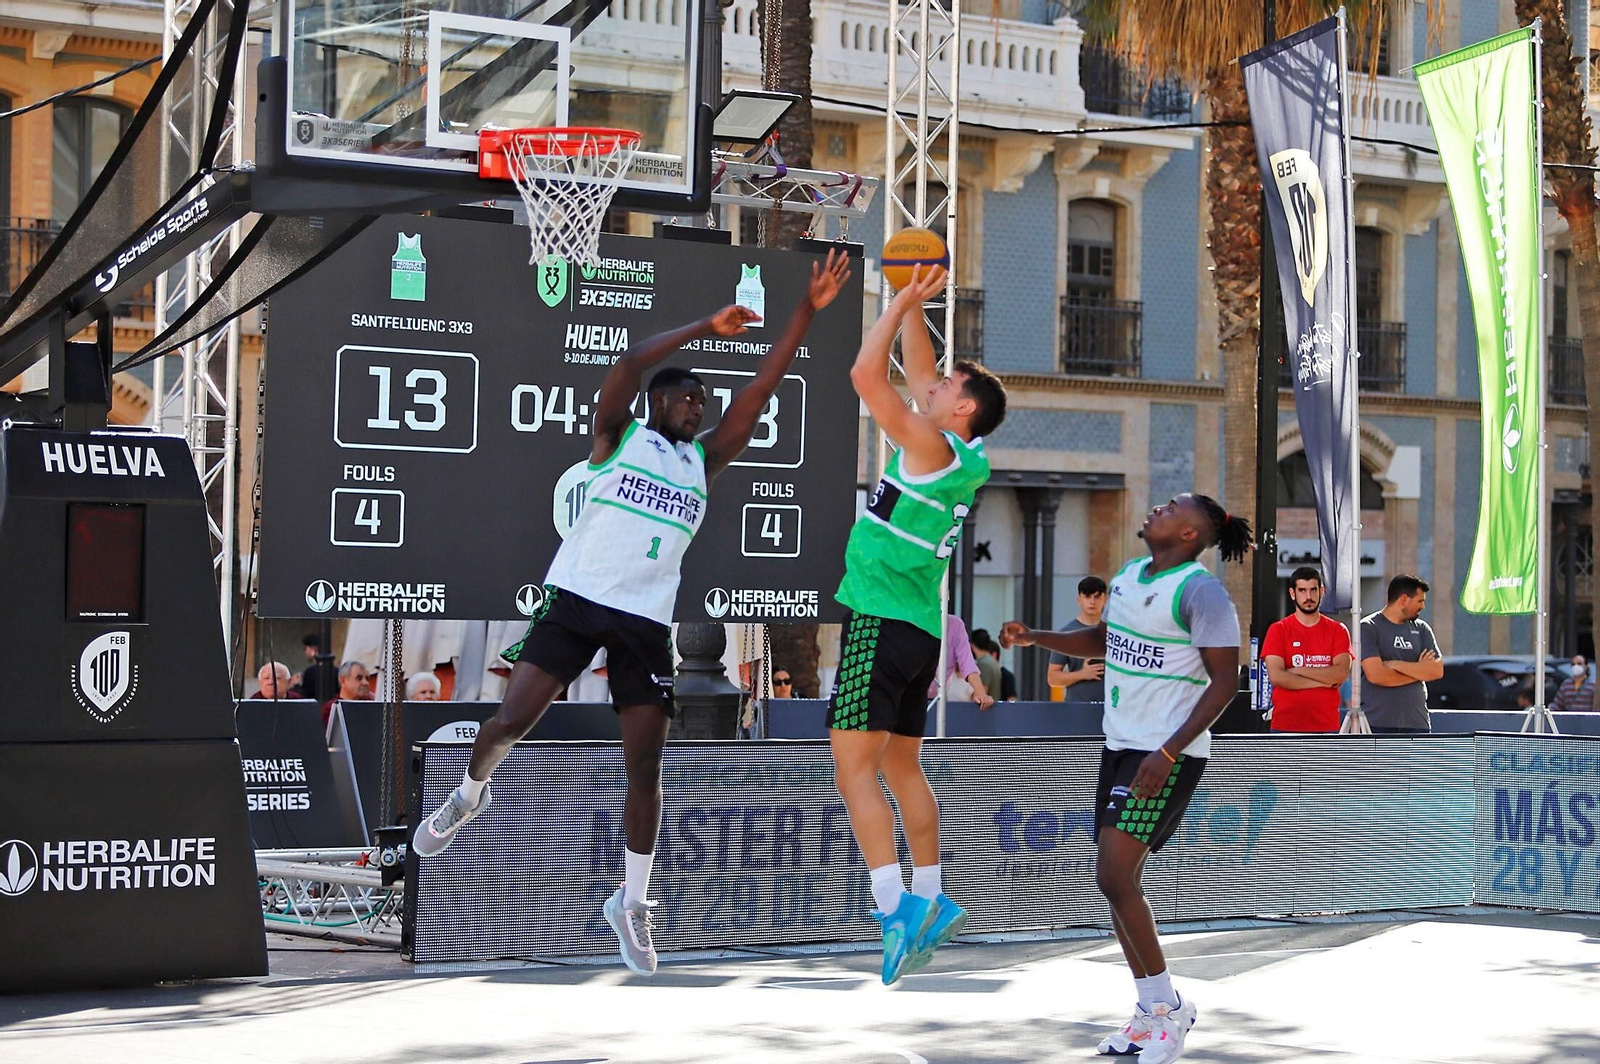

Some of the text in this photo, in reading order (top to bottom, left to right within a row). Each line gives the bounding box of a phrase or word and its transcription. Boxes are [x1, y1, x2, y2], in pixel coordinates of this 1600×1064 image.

[332, 127, 367, 135] NUTRITION
[322, 136, 366, 147] 3X3SERIES
[635, 158, 683, 170] HERBALIFE
[635, 166, 683, 178] NUTRITION
[118, 197, 208, 269] Schelde Sports
[598, 257, 654, 272] HERBALIFE
[597, 269, 654, 284] NUTRITION
[579, 289, 653, 310] 3X3SERIES
[351, 313, 473, 335] SANTFELIUENC 3X3
[564, 323, 628, 352] HUELVA
[564, 353, 580, 363] 9-10
[580, 354, 590, 364] DE
[589, 355, 609, 365] JUNIO
[367, 365, 448, 432] 13
[41, 441, 166, 478] HUELVA
[343, 464, 395, 482] FOULS
[621, 473, 701, 513] HERBALIFE
[752, 482, 794, 498] FOULS
[353, 498, 381, 535] 4
[760, 513, 783, 546] 4
[646, 537, 662, 560] 1
[338, 582, 446, 598] HERBALIFE
[731, 589, 818, 605] HERBALIFE
[338, 597, 446, 613] NUTRITION
[730, 603, 818, 618] NUTRITION
[110, 636, 126, 645] FEB
[1107, 631, 1165, 658] RBALIFE
[1107, 645, 1163, 669] TRITION
[455, 727, 476, 738] FEB
[241, 759, 304, 771] RBALIFE
[246, 793, 310, 811] SERIES
[1494, 781, 1600, 847] MÁS
[43, 837, 216, 865] HERBALIFE
[43, 863, 216, 892] NUTRITION
[1492, 846, 1581, 897] 28 Y
[701, 874, 760, 932] 29
[770, 871, 828, 928] DE
